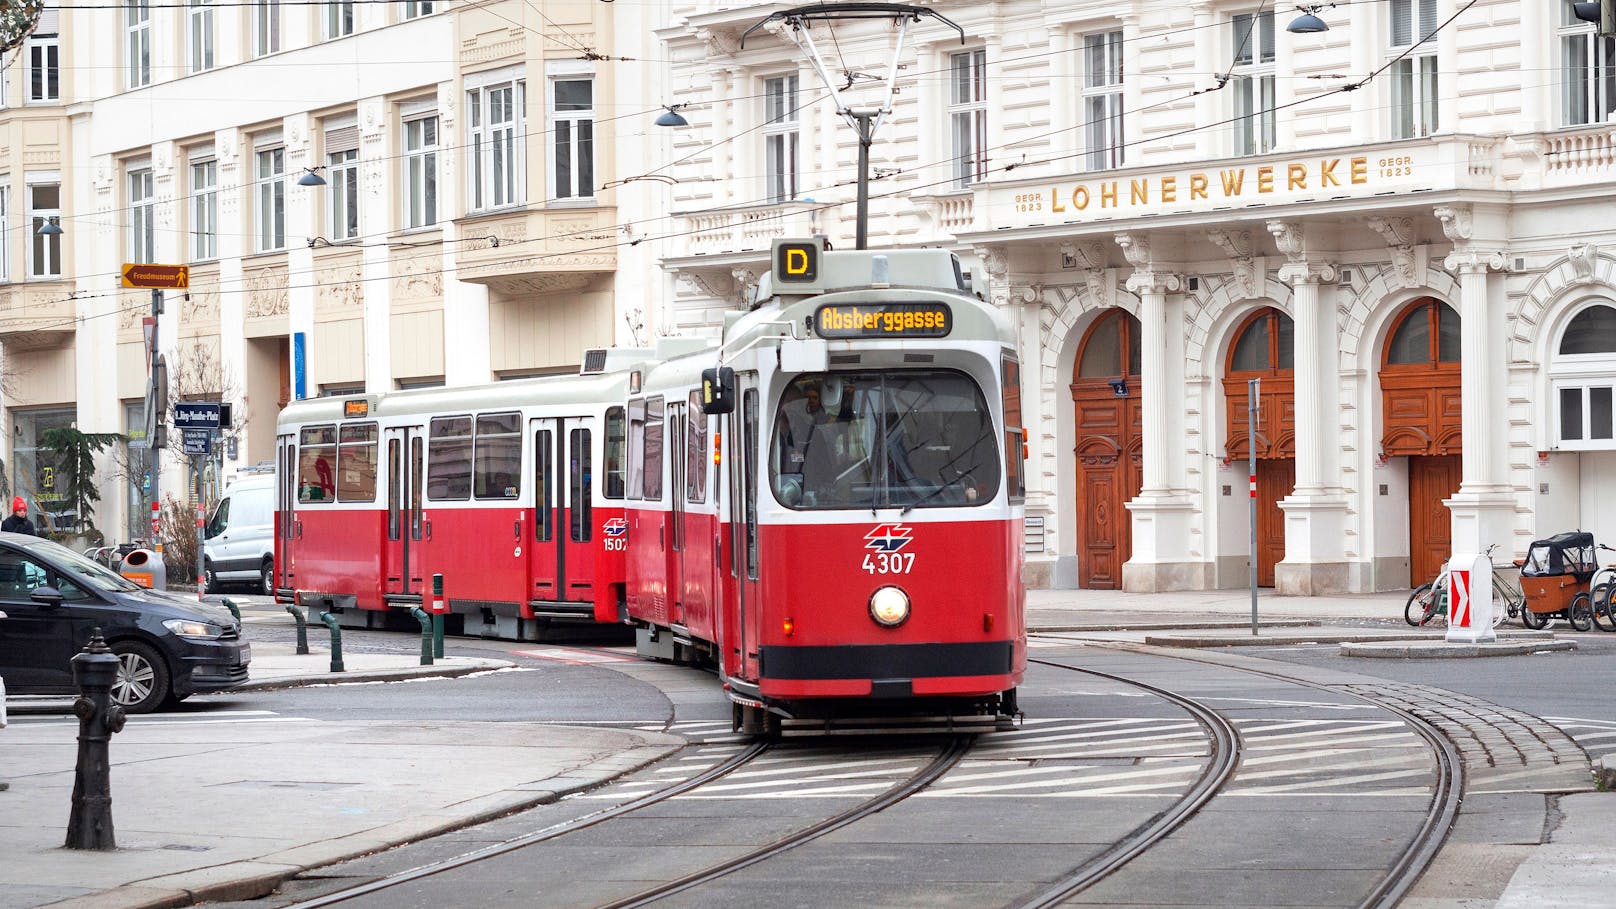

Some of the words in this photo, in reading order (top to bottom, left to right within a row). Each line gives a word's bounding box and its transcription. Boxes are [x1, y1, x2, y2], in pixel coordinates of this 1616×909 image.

[1379, 156, 1414, 167] GEGR.
[1380, 168, 1412, 178] 1823
[1052, 156, 1367, 212] LOHNERWERKE
[1015, 193, 1043, 203] GEGR.
[1015, 203, 1042, 213] 1823
[787, 249, 808, 274] D
[134, 272, 175, 280] Freudmuseum
[822, 307, 945, 331] Absberggasse
[861, 552, 916, 575] 4307
